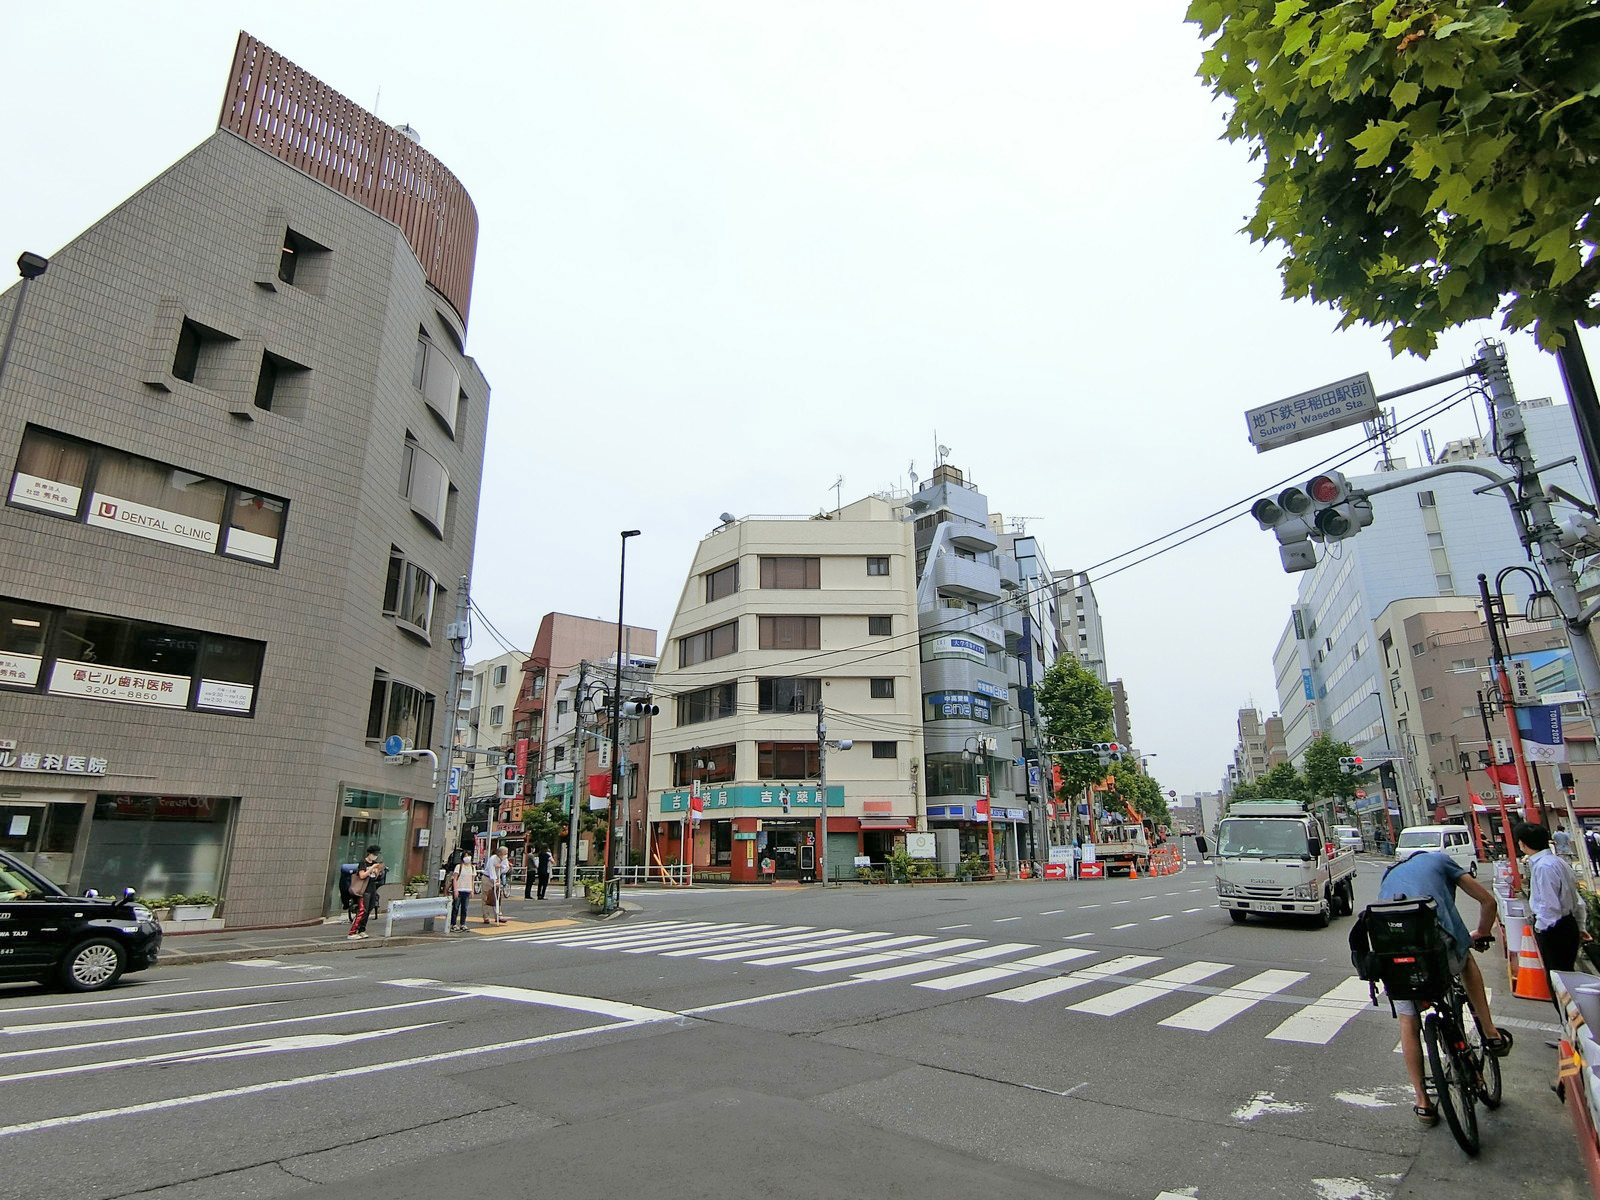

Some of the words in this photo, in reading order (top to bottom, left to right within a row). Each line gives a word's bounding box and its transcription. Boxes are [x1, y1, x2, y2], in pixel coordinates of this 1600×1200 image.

[1252, 381, 1367, 428] 地下鉄早稲田駅前
[1259, 420, 1297, 438] Subway
[1301, 408, 1342, 425] Waseda
[1345, 400, 1367, 411] Sta.
[101, 503, 116, 518] U
[121, 511, 169, 531] DENTAL
[174, 525, 213, 541] CLINIC
[73, 669, 174, 693] 優ビル歯科医院
[85, 685, 158, 701] 3204-8850
[993, 685, 1008, 699] ena
[942, 703, 972, 715] ena
[974, 706, 989, 720] ena
[1549, 710, 1558, 729] TOKYO
[1552, 729, 1560, 744] 2020
[0, 751, 108, 774] ル歯科医院
[672, 791, 728, 809] 吉薬局
